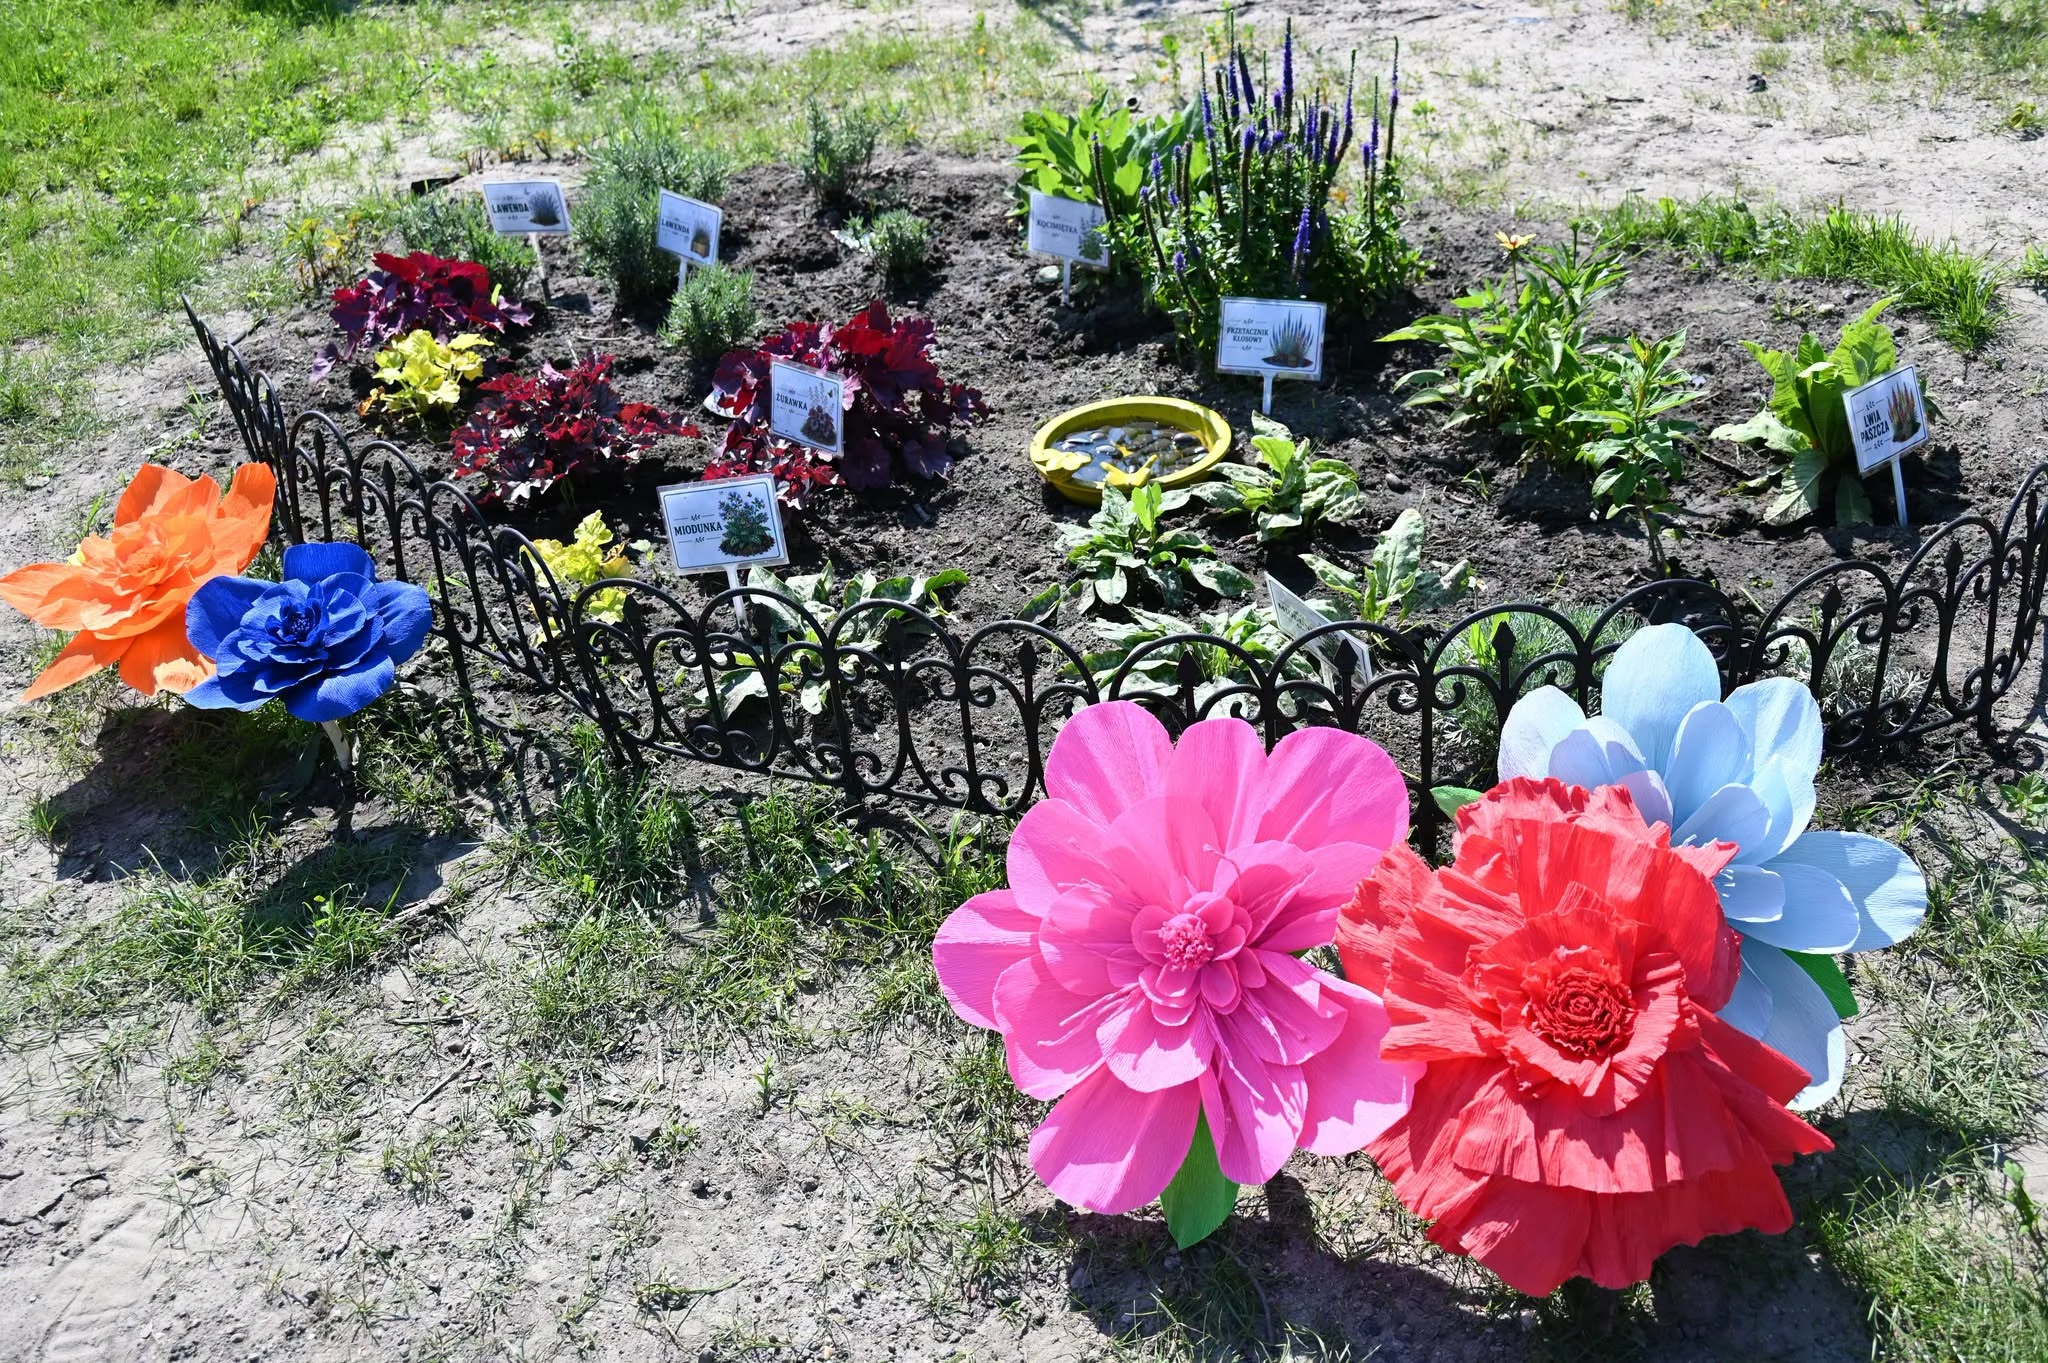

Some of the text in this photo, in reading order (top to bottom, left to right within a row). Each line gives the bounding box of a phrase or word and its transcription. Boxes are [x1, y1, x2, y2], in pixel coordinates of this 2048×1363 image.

[491, 202, 530, 214] LAWENDA
[661, 218, 690, 234] LAWENDA
[1226, 326, 1269, 336] PRZETACZNIK
[1863, 409, 1882, 428] LWIA
[1860, 420, 1890, 444] PASZCZA
[673, 521, 723, 537] MIODUNKA
